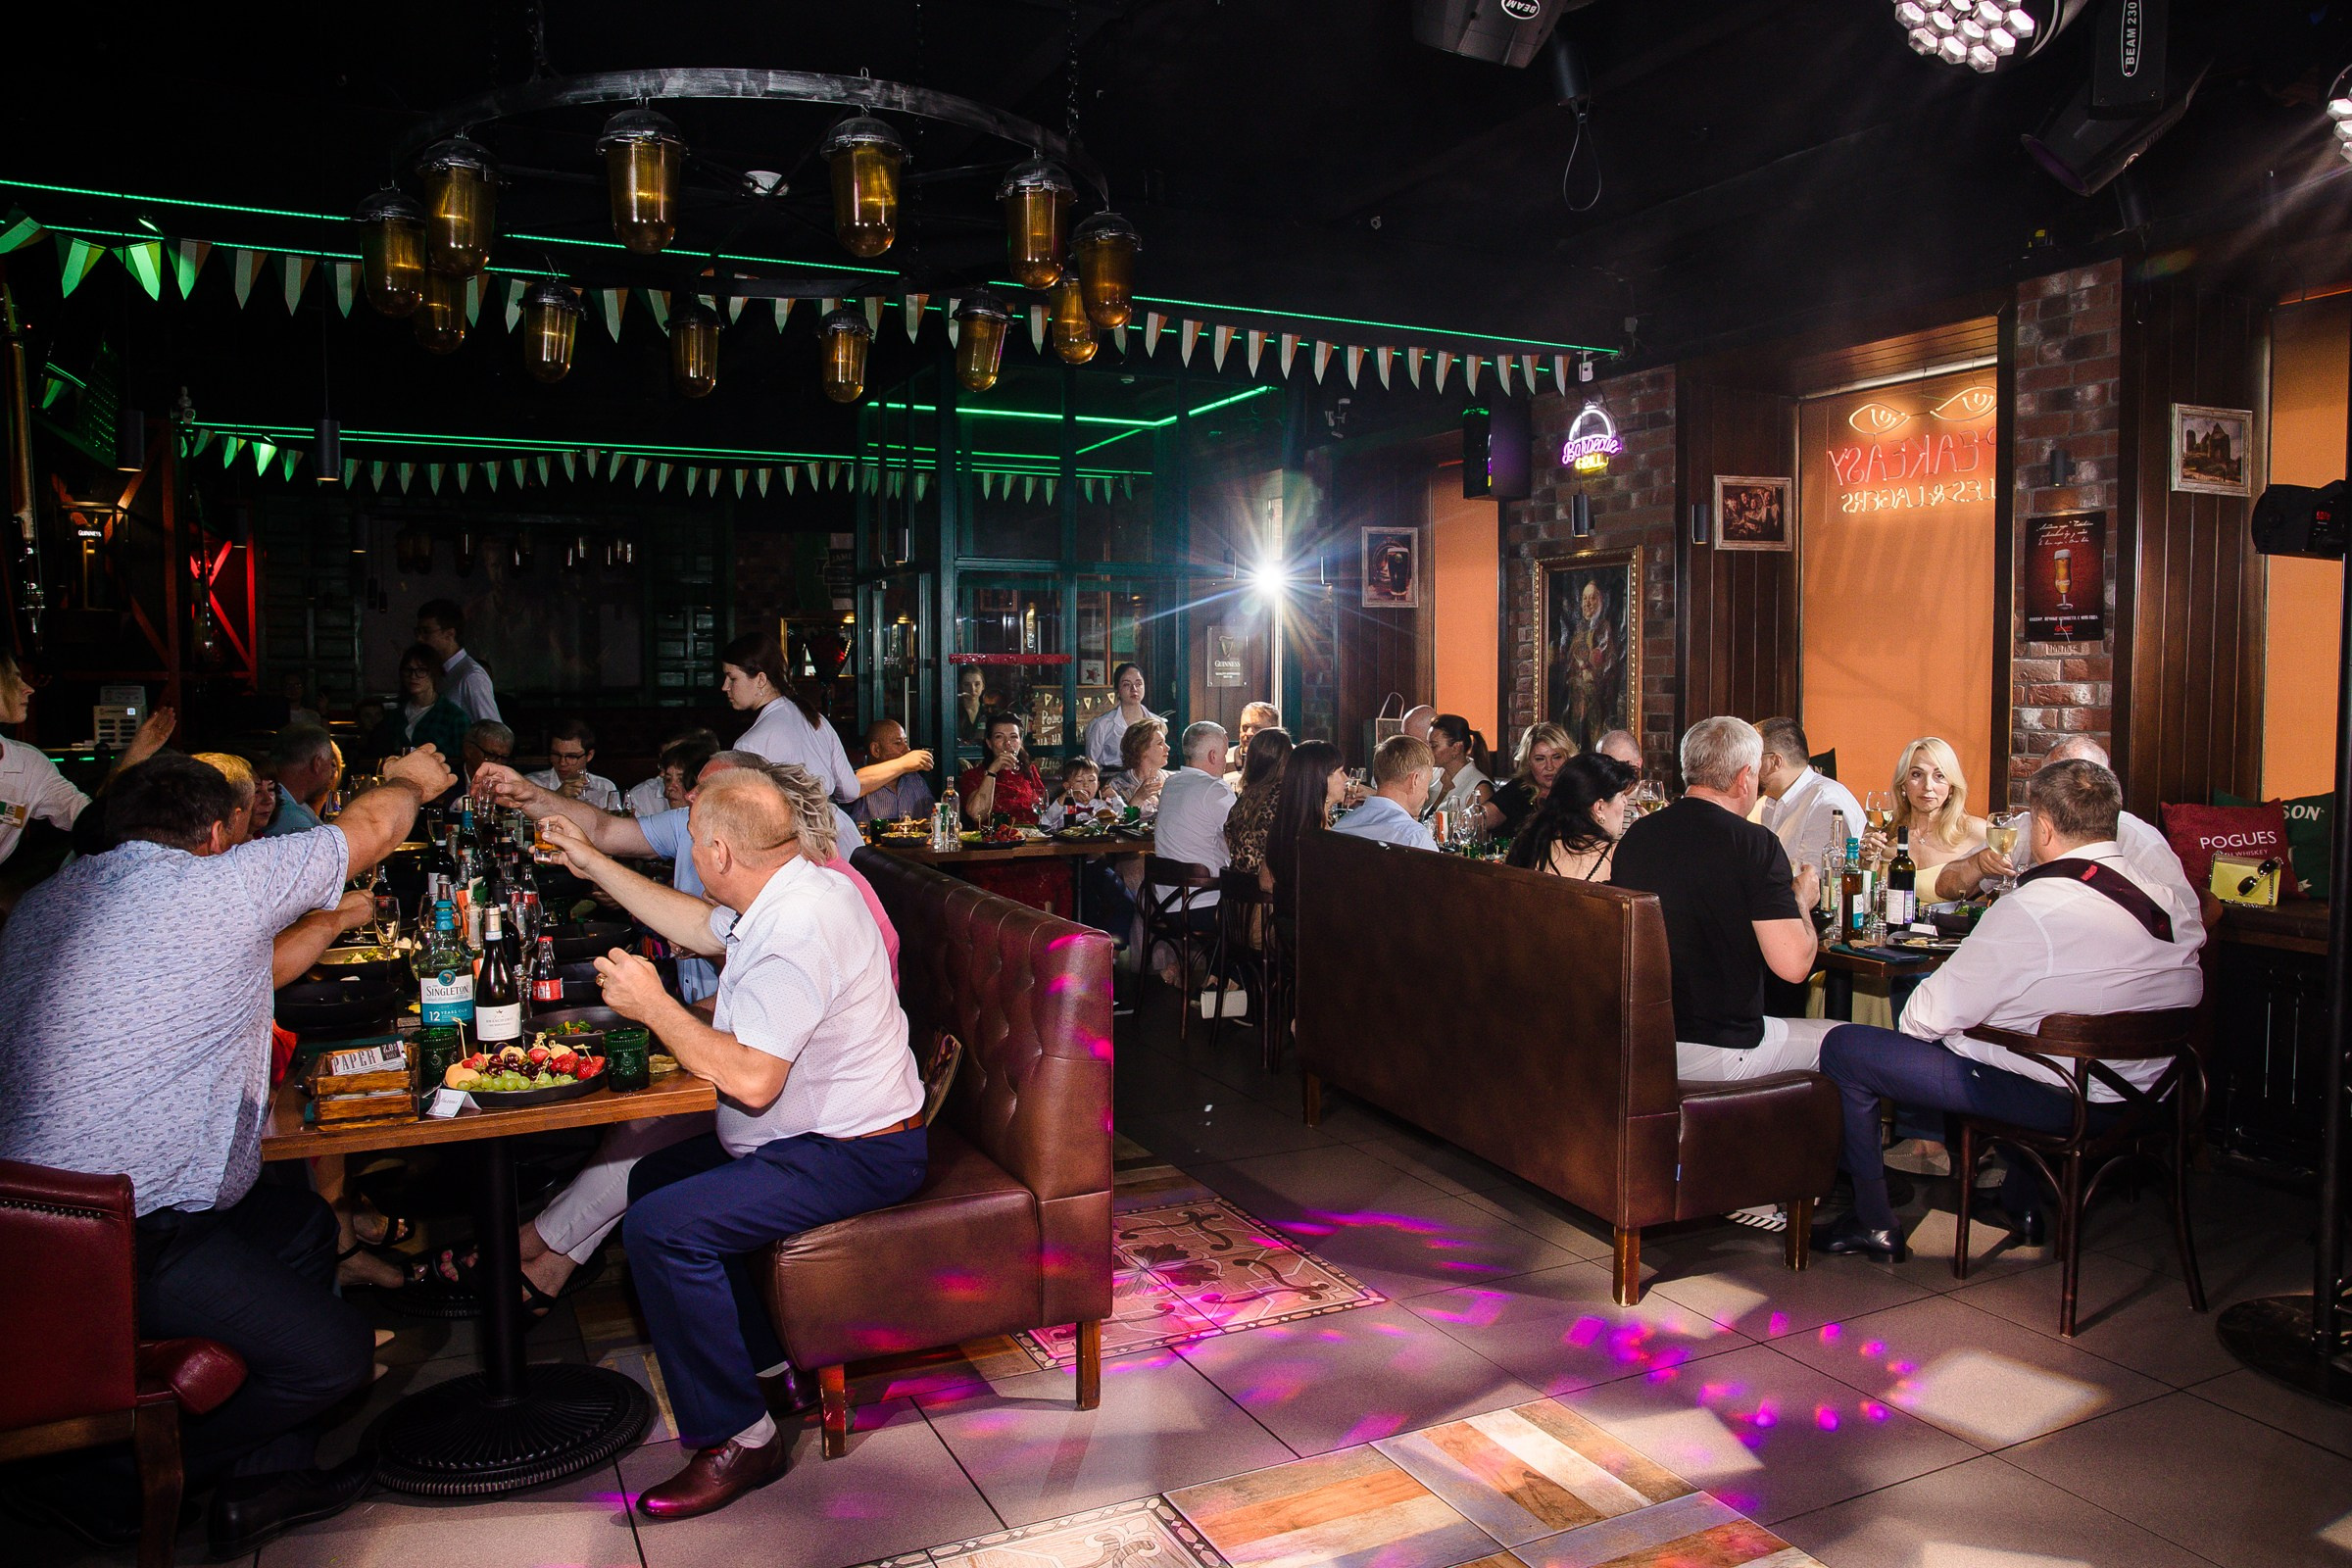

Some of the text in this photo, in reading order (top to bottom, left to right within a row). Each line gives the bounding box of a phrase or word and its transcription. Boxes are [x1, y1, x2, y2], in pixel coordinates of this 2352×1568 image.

[1505, 0, 1538, 14] BEAM
[2126, 2, 2137, 65] BEAM 230
[2199, 830, 2278, 850] POGUES
[2235, 849, 2269, 858] WHISKEY
[425, 985, 468, 997] SINGLETON
[429, 1011, 441, 1021] 12
[333, 1049, 376, 1073] PAPER
